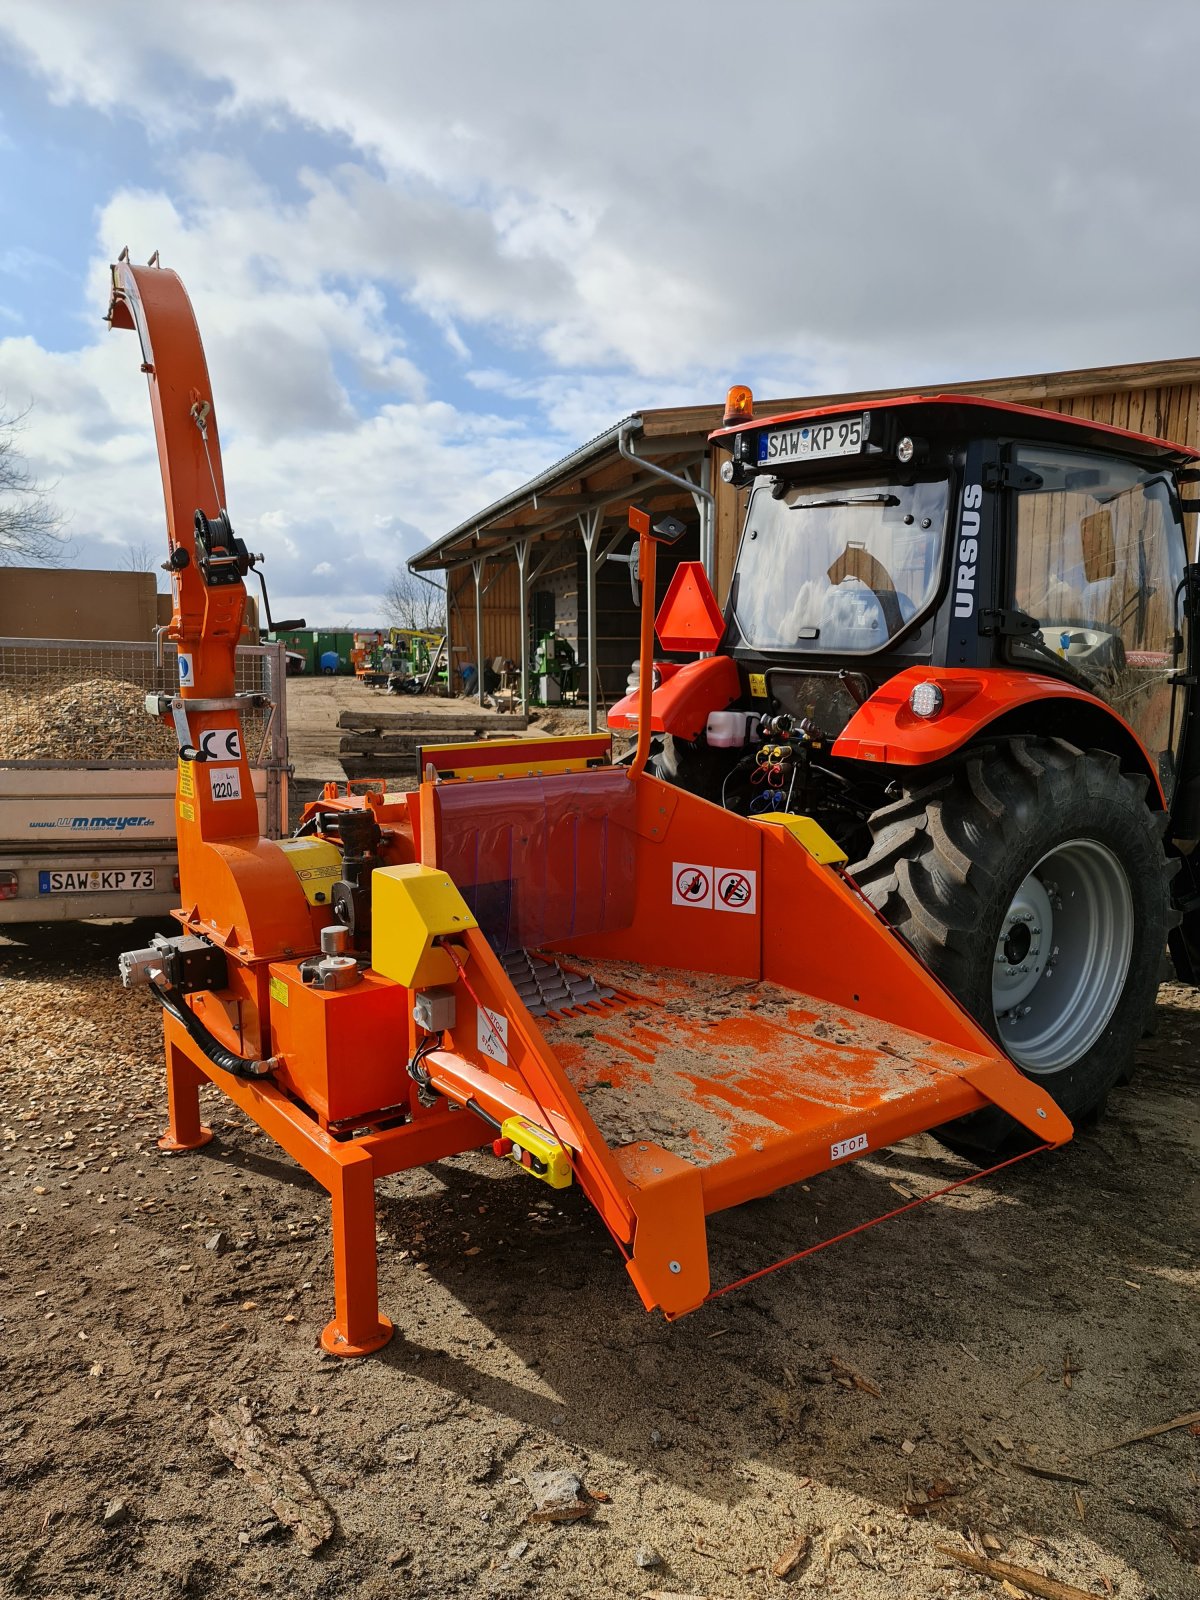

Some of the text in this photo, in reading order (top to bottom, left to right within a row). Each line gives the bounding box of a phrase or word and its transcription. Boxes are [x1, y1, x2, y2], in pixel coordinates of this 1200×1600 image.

[768, 432, 800, 458] SAW
[811, 426, 834, 452] KP
[838, 421, 861, 448] 95
[954, 484, 983, 618] URSUS
[51, 873, 89, 890] SAW
[102, 872, 126, 889] KP
[130, 871, 153, 888] 73
[489, 1012, 503, 1033] STOP
[481, 1034, 495, 1055] STOP
[832, 1136, 864, 1157] STOP
